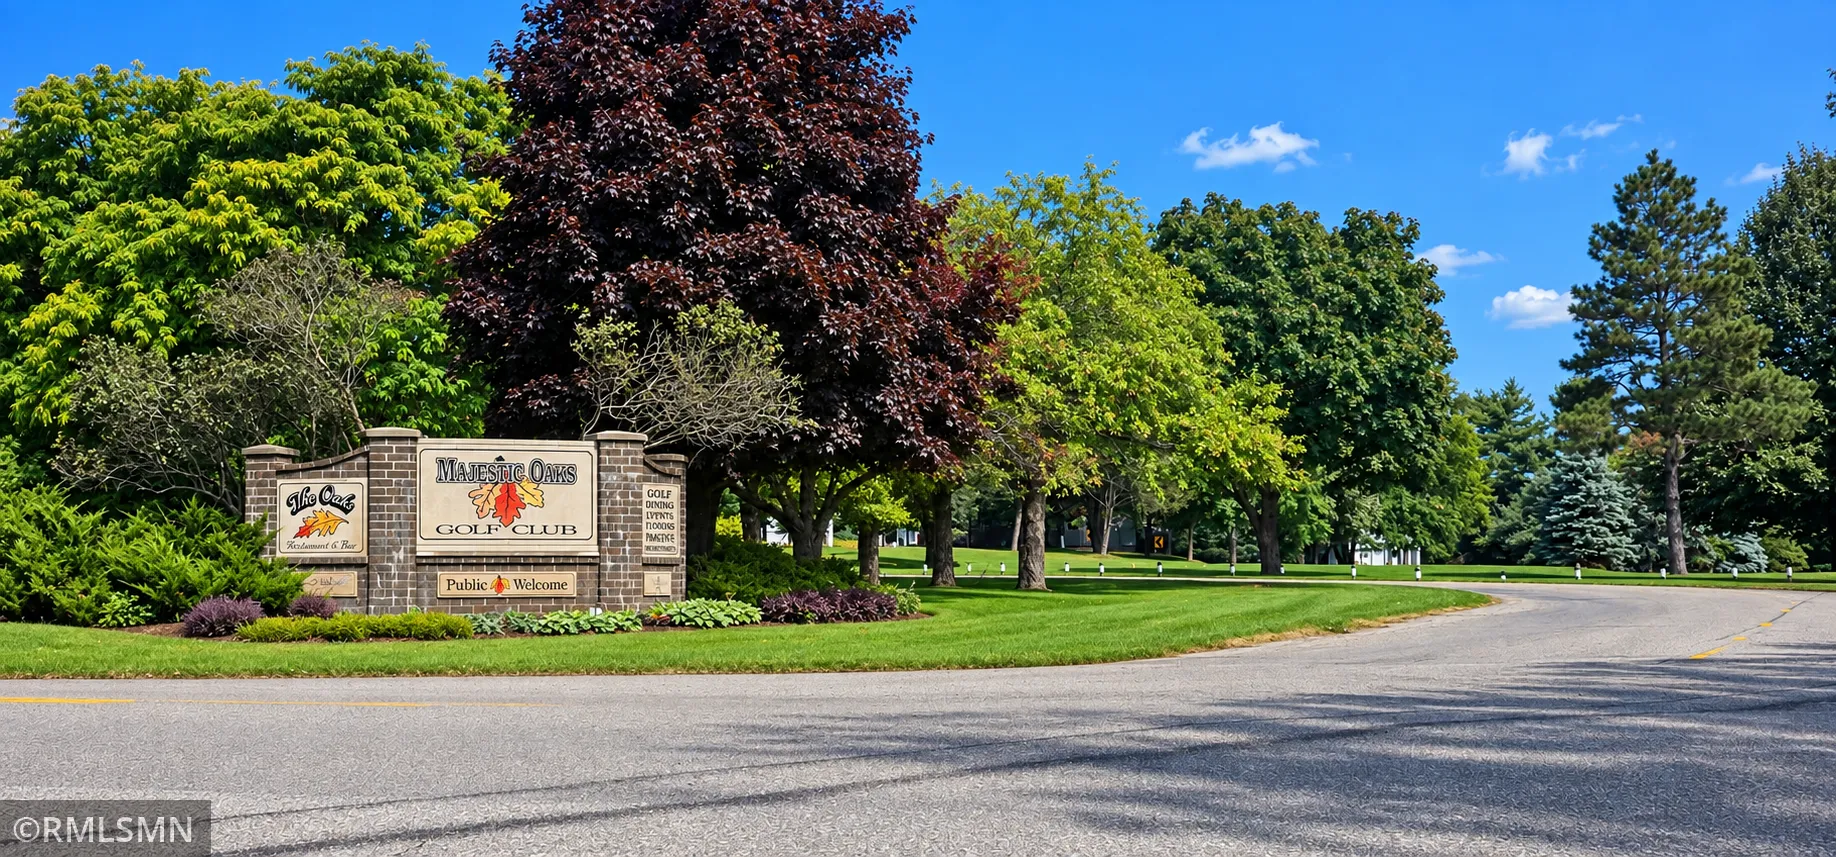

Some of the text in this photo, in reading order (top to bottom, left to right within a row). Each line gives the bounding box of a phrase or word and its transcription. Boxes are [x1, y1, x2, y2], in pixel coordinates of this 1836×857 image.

[646, 489, 672, 499] GOLF
[286, 484, 356, 516] The Oaks
[645, 500, 675, 510] DINING
[436, 524, 577, 535] GOLF CLUB
[446, 579, 568, 591] Public Welcome
